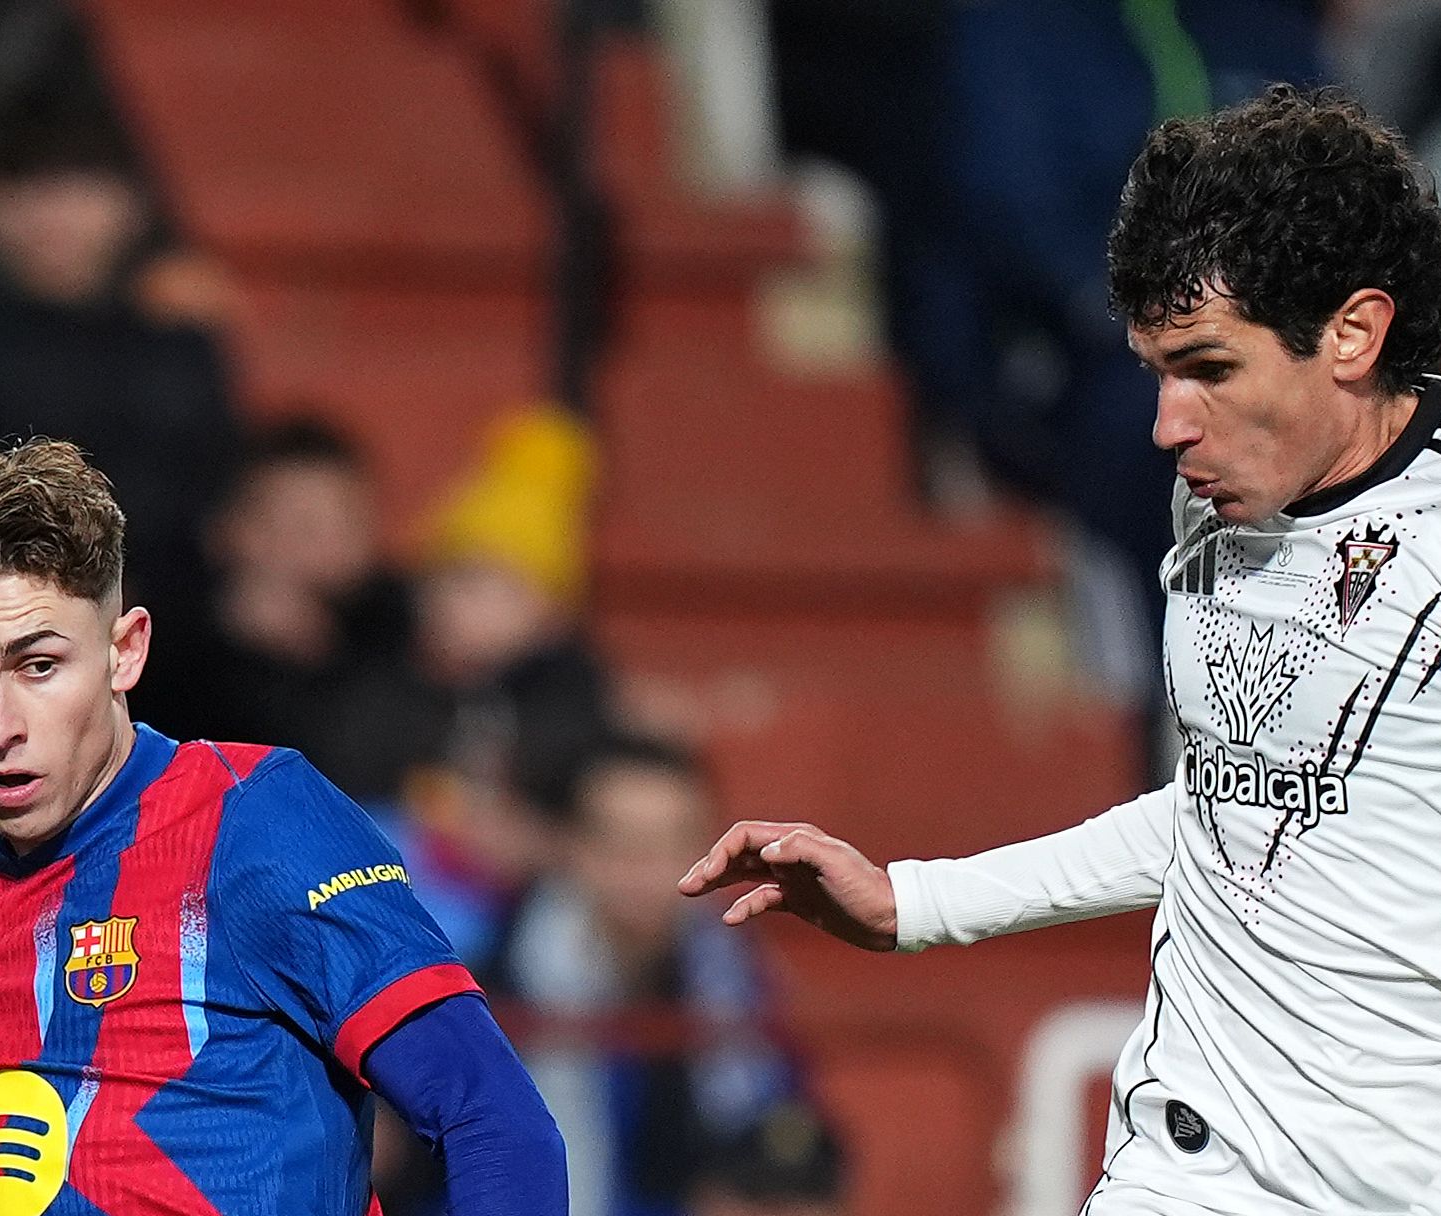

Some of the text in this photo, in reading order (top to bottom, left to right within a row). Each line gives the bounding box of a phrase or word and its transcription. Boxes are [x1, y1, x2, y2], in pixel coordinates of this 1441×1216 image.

[1184, 743, 1348, 828] Globalcaja
[307, 863, 408, 912] AMBILIGHT
[86, 954, 114, 967] FCB
